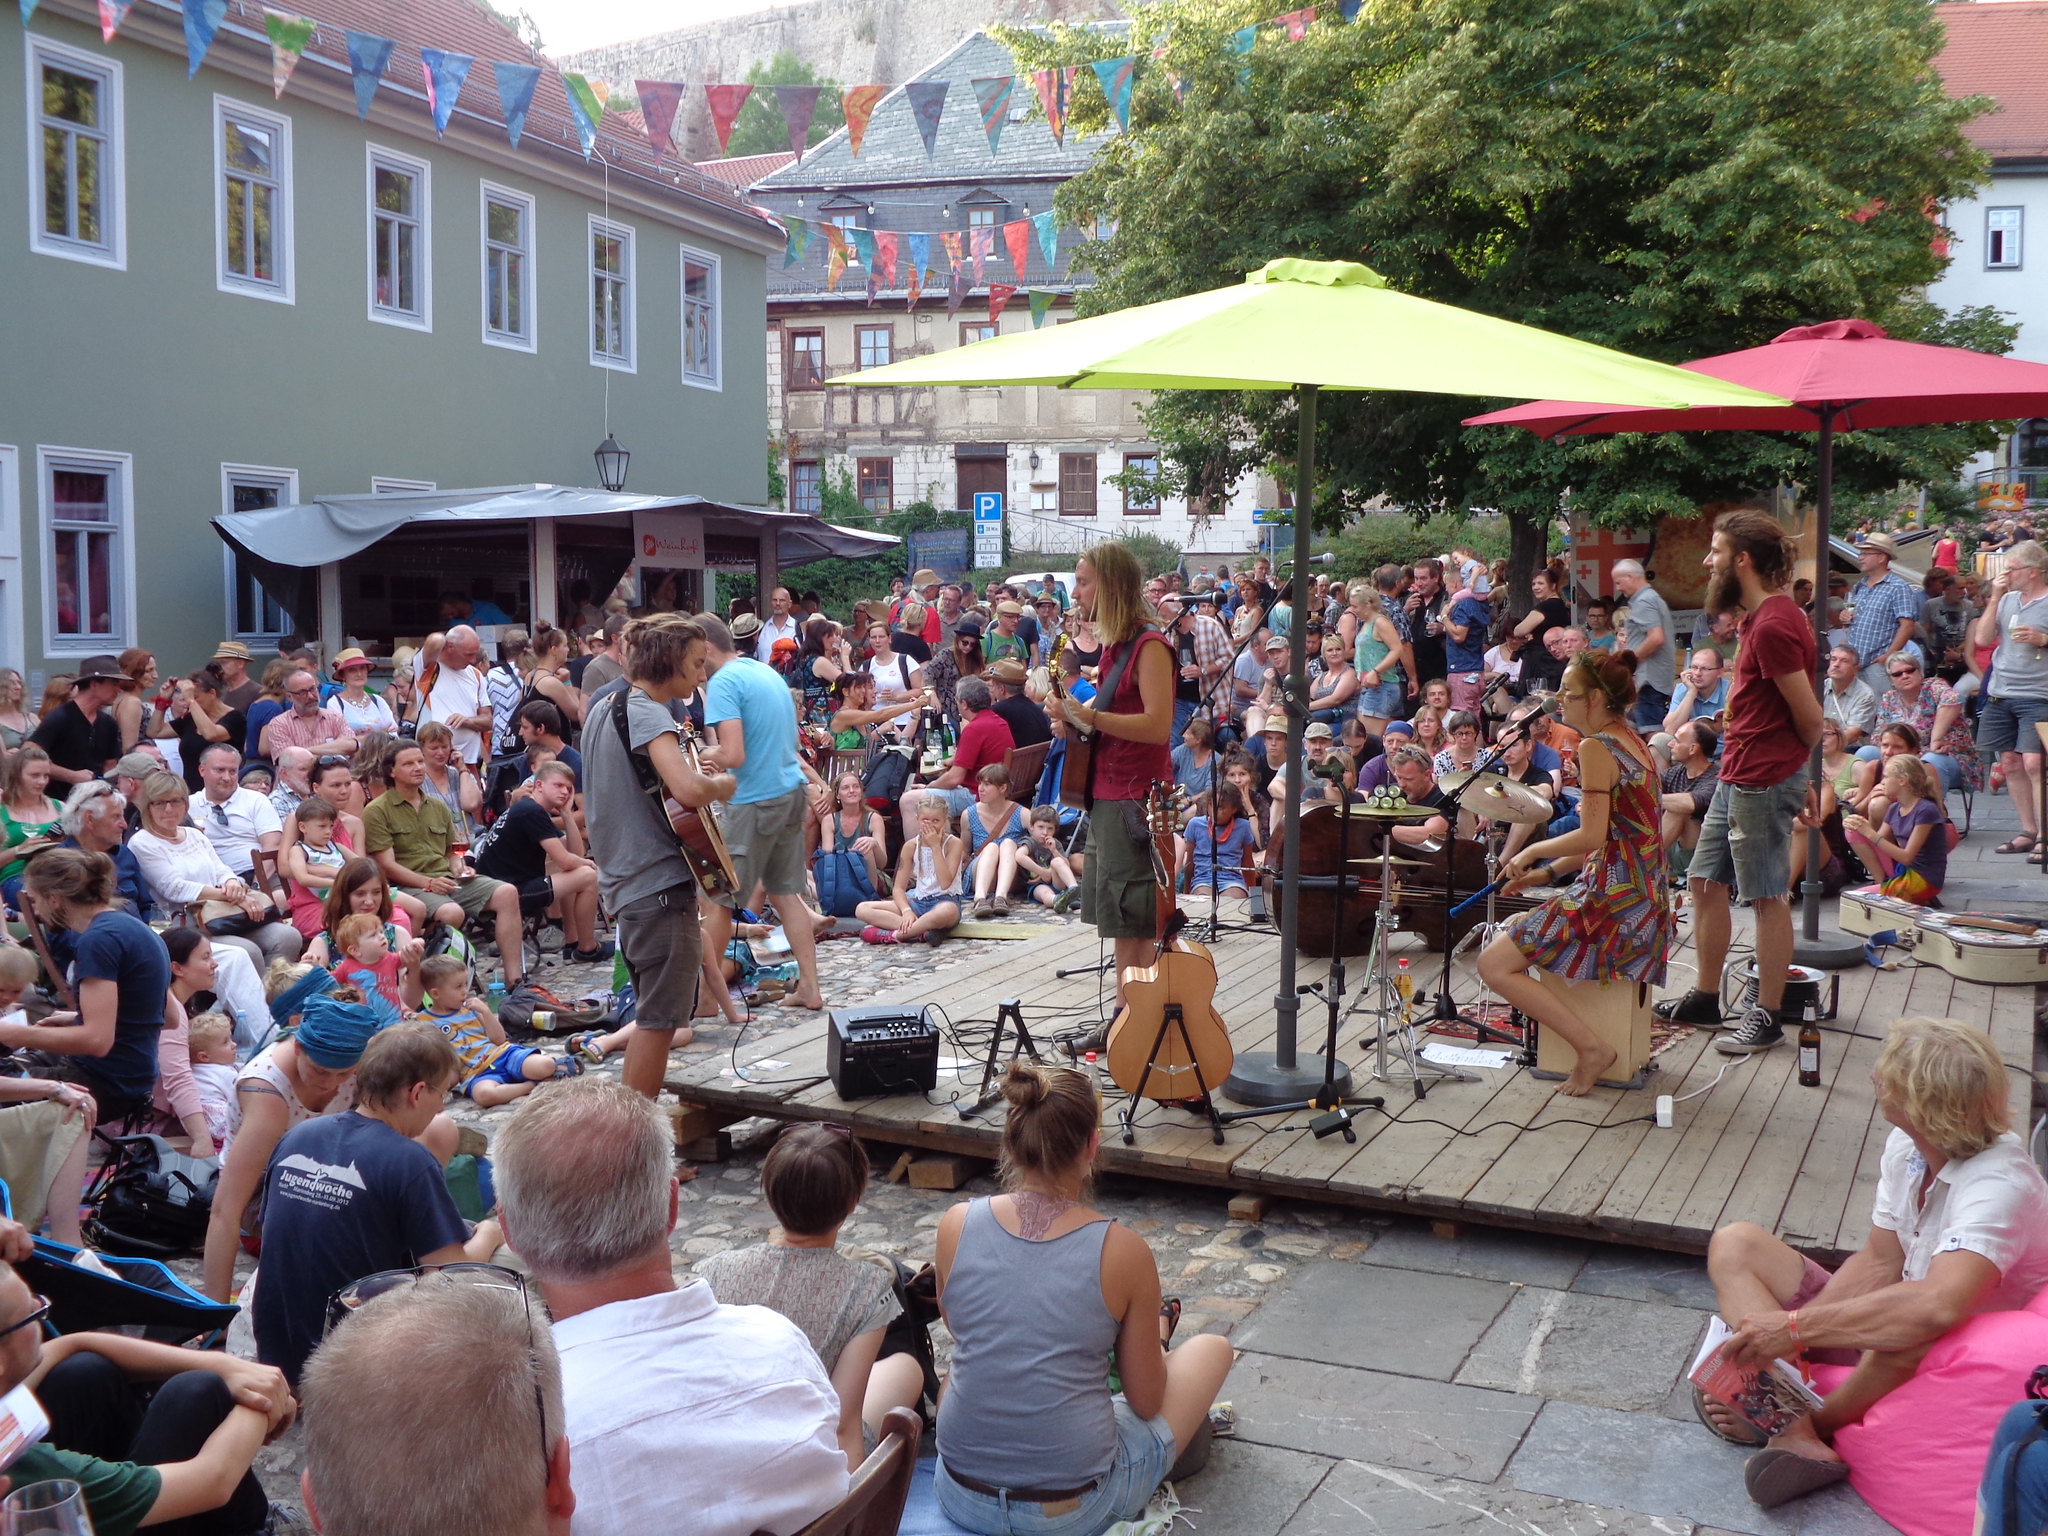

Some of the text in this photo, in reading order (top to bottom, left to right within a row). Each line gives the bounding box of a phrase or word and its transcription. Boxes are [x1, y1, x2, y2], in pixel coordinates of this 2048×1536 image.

[980, 496, 995, 518] P
[655, 537, 699, 555] Weinhof
[280, 1169, 353, 1199] Jugendwoche
